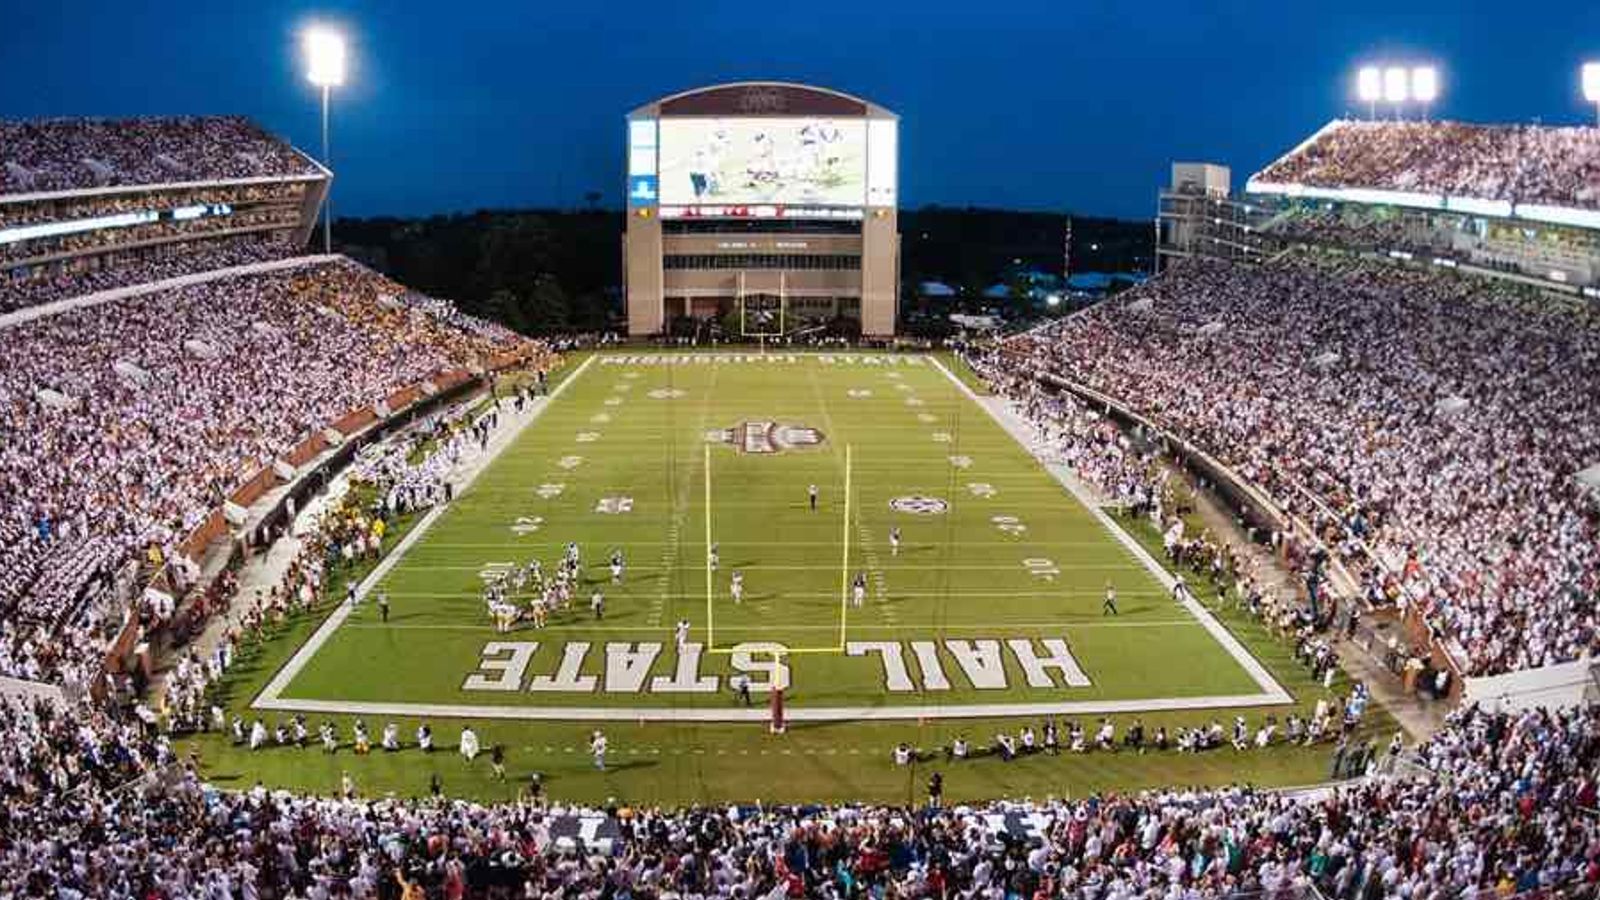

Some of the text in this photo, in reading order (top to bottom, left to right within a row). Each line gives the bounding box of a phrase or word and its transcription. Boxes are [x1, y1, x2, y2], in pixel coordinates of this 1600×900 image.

[1022, 558, 1060, 574] 10
[461, 638, 1093, 692] HAIL STATE
